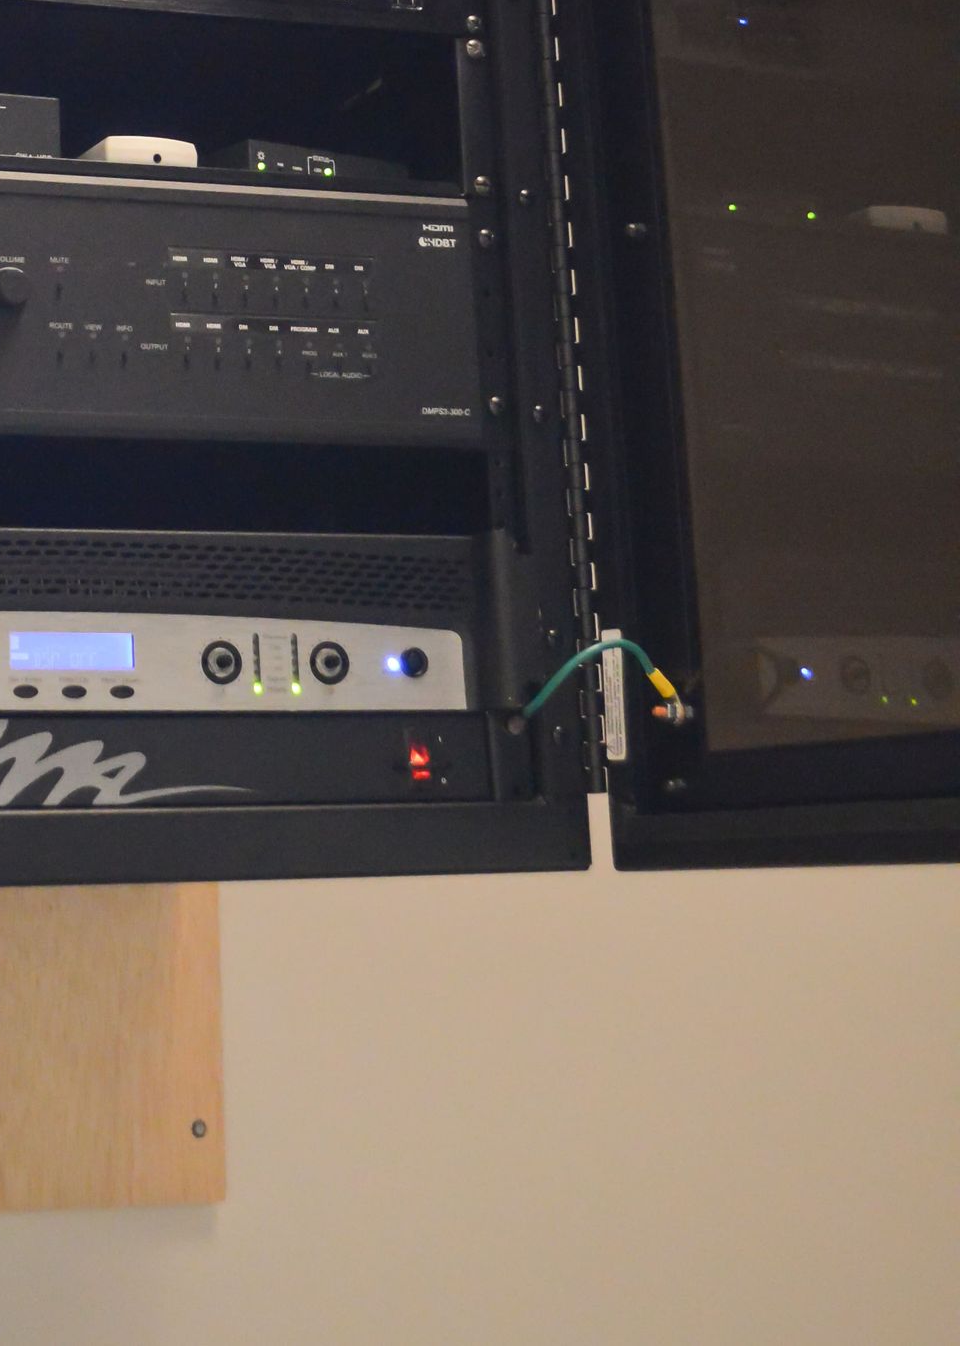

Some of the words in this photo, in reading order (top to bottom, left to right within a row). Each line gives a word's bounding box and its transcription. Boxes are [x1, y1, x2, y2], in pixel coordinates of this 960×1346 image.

[422, 224, 454, 232] HDMI
[50, 256, 69, 264] MUTE
[49, 322, 74, 330] ROUTE
[84, 324, 102, 332] VIEW
[140, 342, 168, 351] OUTPUT
[319, 371, 340, 379] LOCAL
[341, 372, 363, 380] AUDIO
